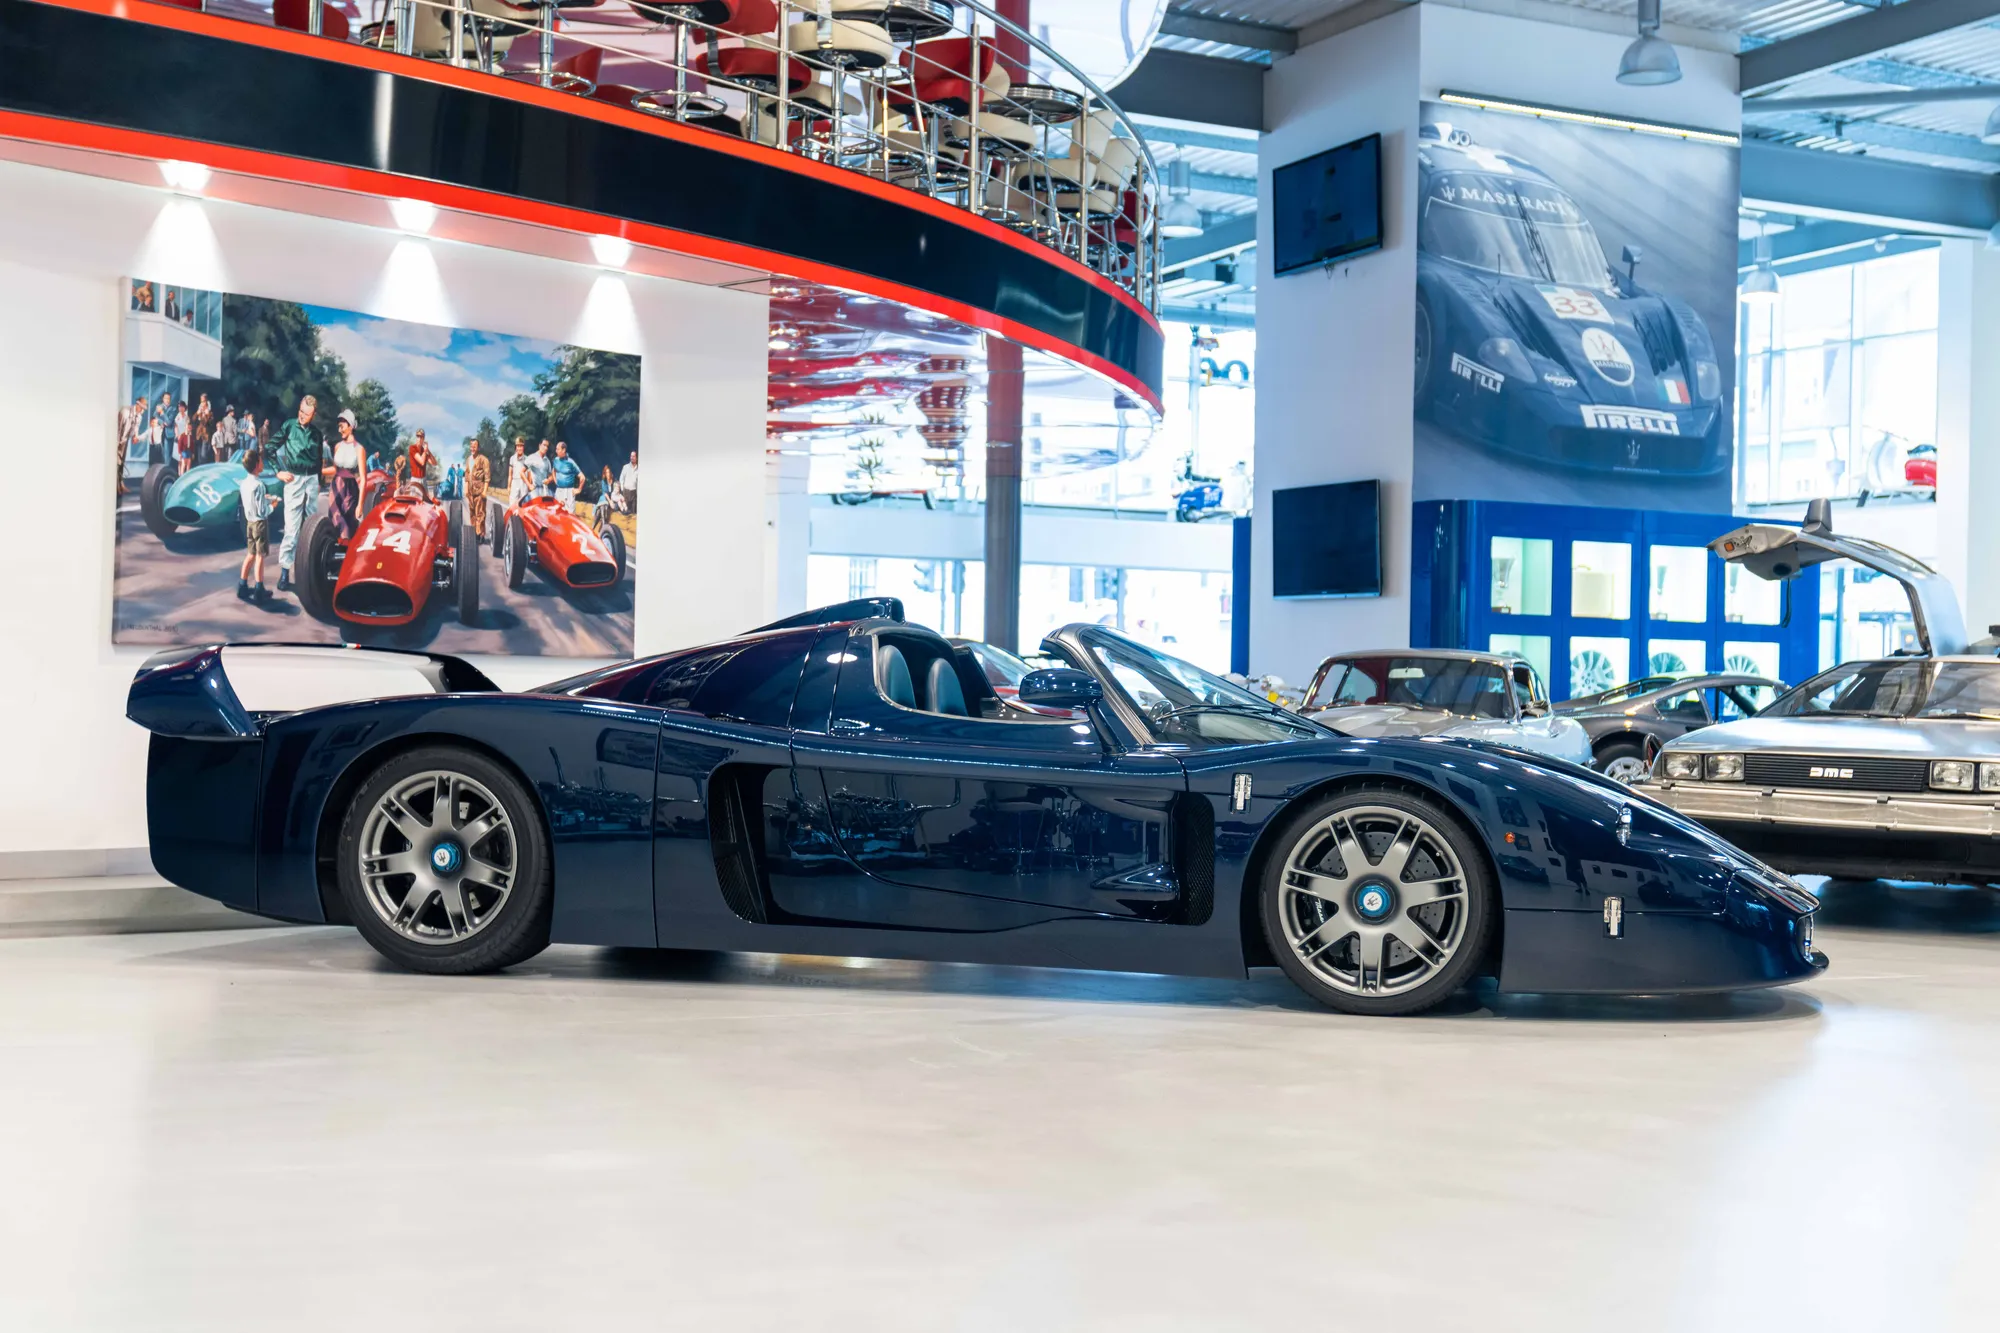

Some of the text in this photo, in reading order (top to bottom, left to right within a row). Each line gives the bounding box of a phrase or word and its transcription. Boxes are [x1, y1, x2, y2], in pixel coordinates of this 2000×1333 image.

[1460, 187, 1567, 216] MASERATI
[1554, 297, 1599, 316] 33
[1580, 404, 1680, 436] PIRELLI
[192, 484, 221, 505] 18
[356, 528, 412, 555] 14
[572, 533, 596, 555] 2
